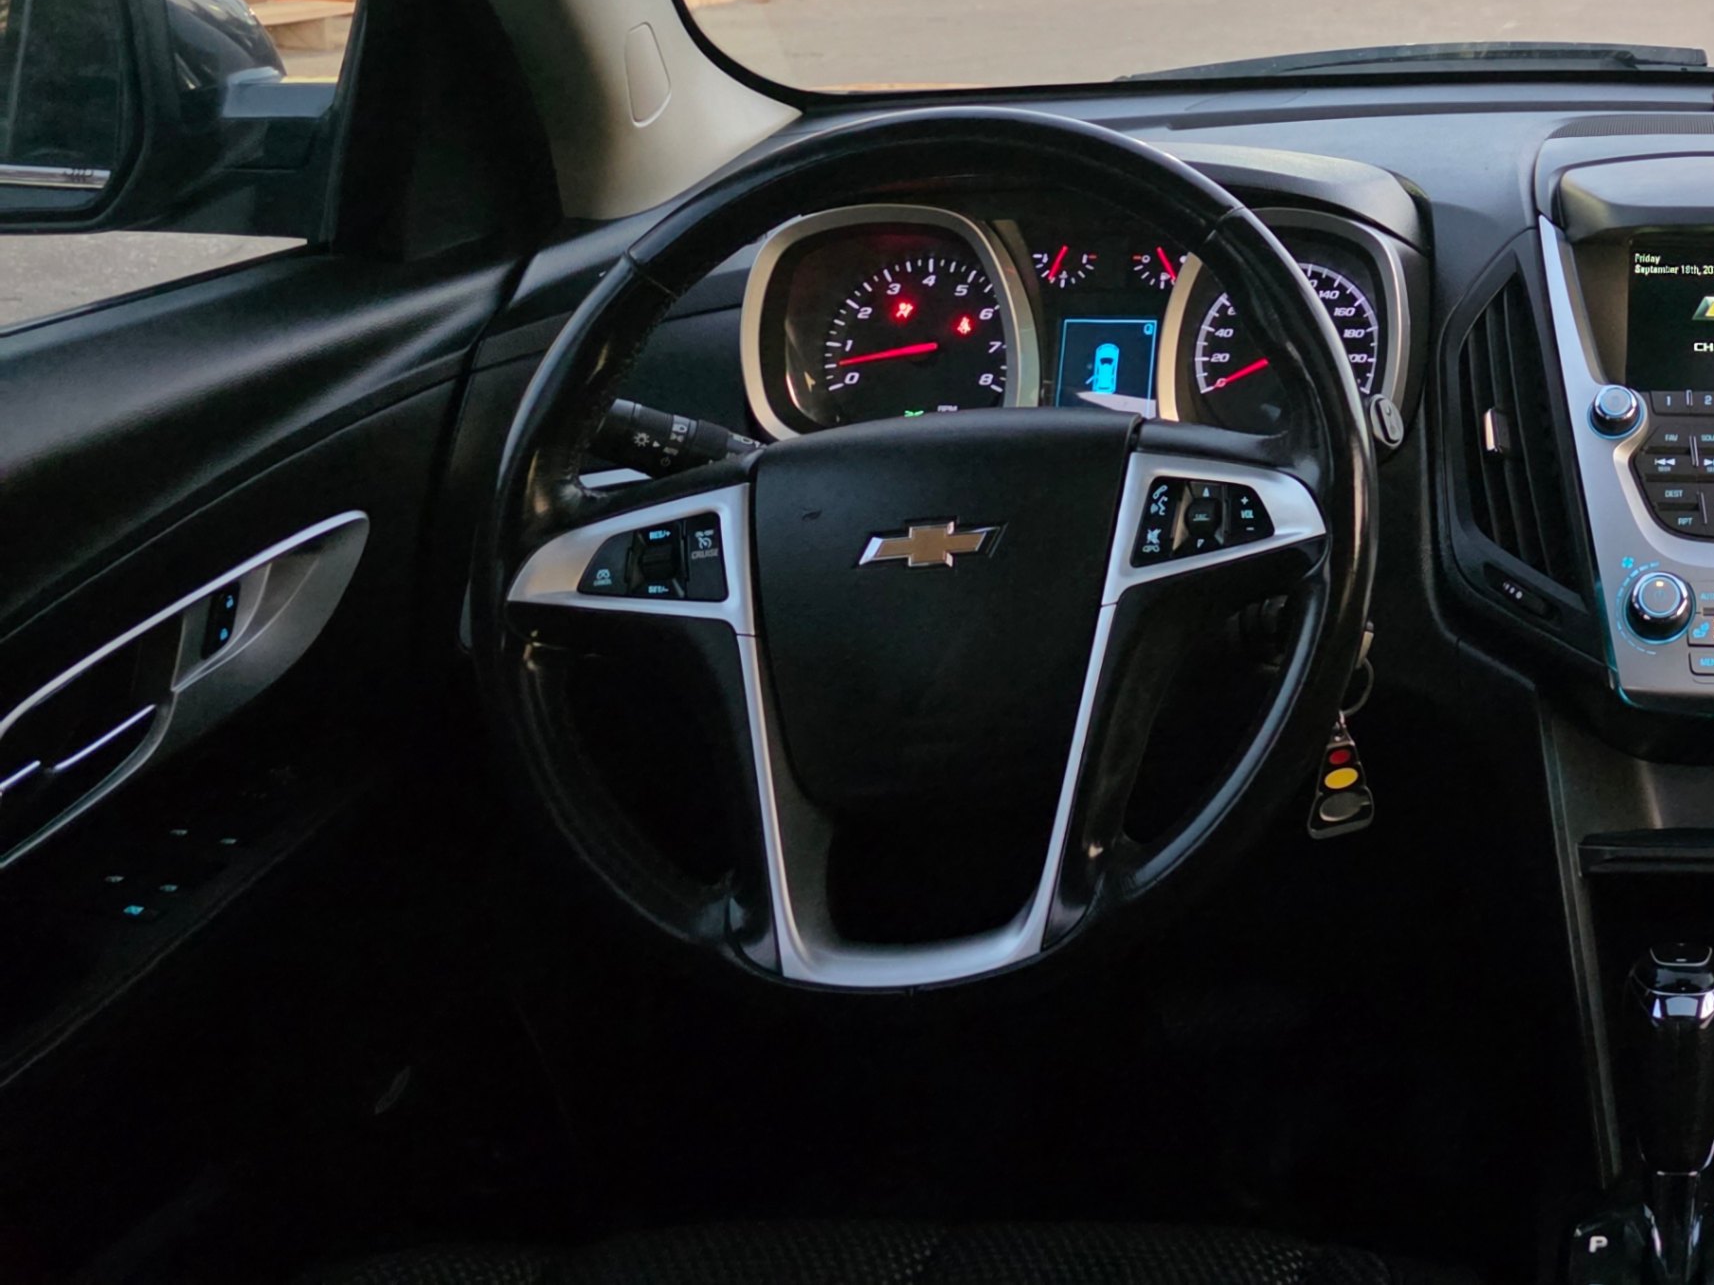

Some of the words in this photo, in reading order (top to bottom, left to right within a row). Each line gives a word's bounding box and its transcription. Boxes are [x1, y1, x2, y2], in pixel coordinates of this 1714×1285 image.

[1634, 253, 1661, 265] Friday
[1634, 264, 1679, 276] September
[921, 274, 937, 286] 4
[886, 283, 902, 296] 3
[954, 284, 970, 297] 5
[857, 307, 873, 320] 2
[979, 308, 994, 320] 6
[1333, 306, 1356, 317] 160
[1214, 328, 1234, 338] 40
[1342, 328, 1365, 339] 180
[844, 339, 854, 352] 1
[988, 341, 1002, 354] 7
[1210, 352, 1230, 363] 20
[1349, 353, 1368, 363] 00
[844, 371, 861, 385] 0
[978, 373, 994, 386] 8
[1666, 396, 1672, 406] 1
[1704, 395, 1713, 406] 2
[1664, 433, 1679, 442] FAV
[1664, 489, 1683, 498] DEST
[1677, 517, 1693, 526] RPT
[691, 548, 719, 560] CRUISE
[1589, 1235, 1608, 1253] P
